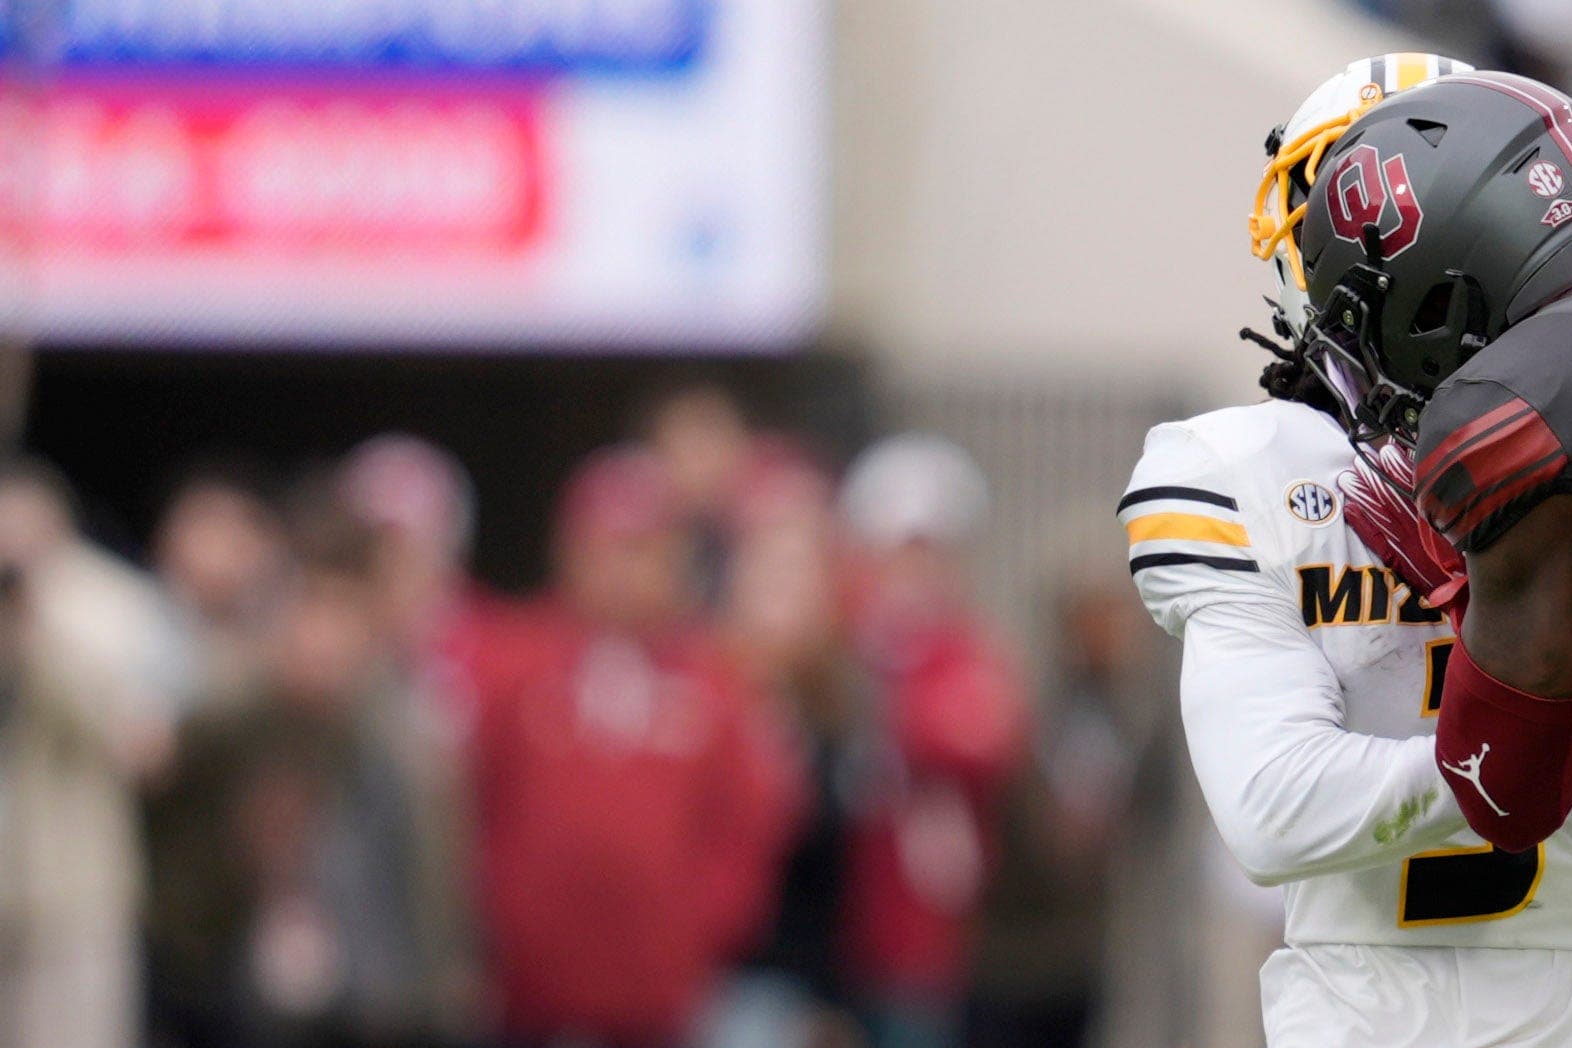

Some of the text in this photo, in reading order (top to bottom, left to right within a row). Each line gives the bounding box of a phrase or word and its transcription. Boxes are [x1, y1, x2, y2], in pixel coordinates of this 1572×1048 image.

[1528, 162, 1564, 197] SEC
[1325, 144, 1424, 262] OU
[1551, 203, 1571, 220] 3.0
[1288, 482, 1334, 521] SEC
